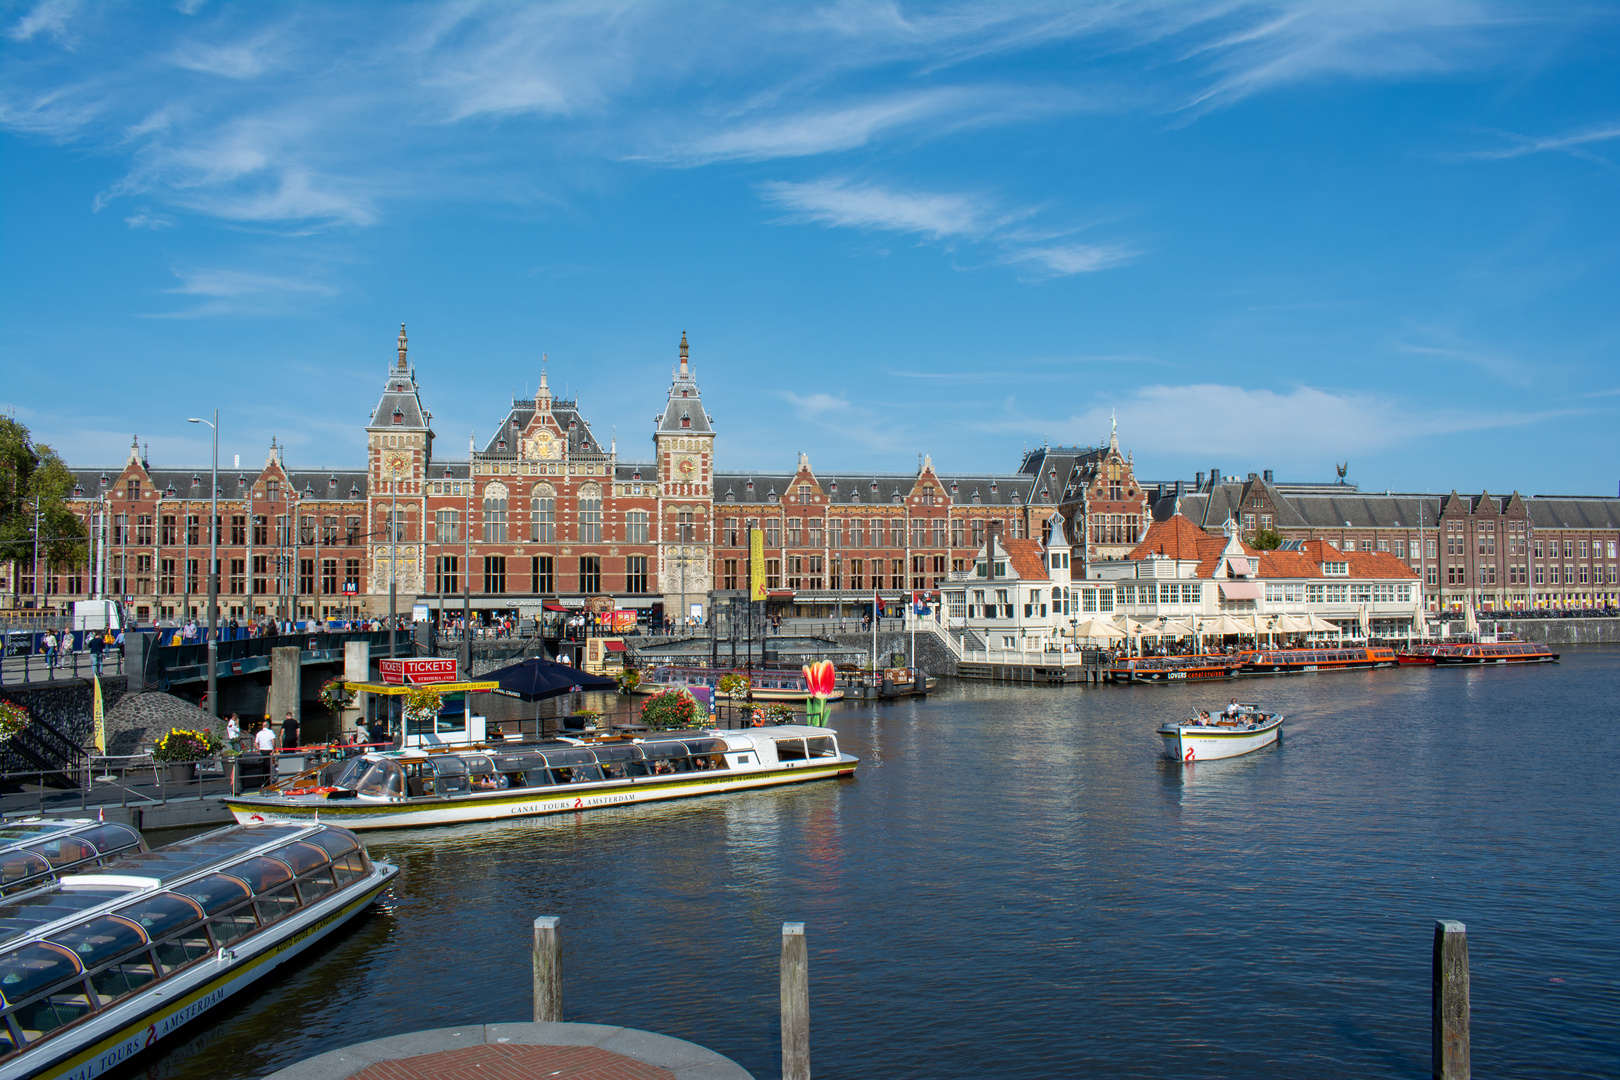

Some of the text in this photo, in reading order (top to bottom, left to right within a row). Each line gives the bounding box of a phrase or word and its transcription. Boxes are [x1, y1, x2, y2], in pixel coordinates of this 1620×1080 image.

[382, 661, 402, 672] TICKETS
[408, 661, 453, 672] TICKETS
[1204, 670, 1225, 678] cruises
[493, 687, 505, 695] CANAL
[511, 794, 635, 814] CANAL TOURS AMSTERDAM
[276, 939, 293, 953] AUDIO
[293, 930, 309, 942] GUIDE
[317, 911, 343, 930] LANGUAGES
[100, 1038, 139, 1071] TOURS
[163, 987, 225, 1034] AMSTERDAM
